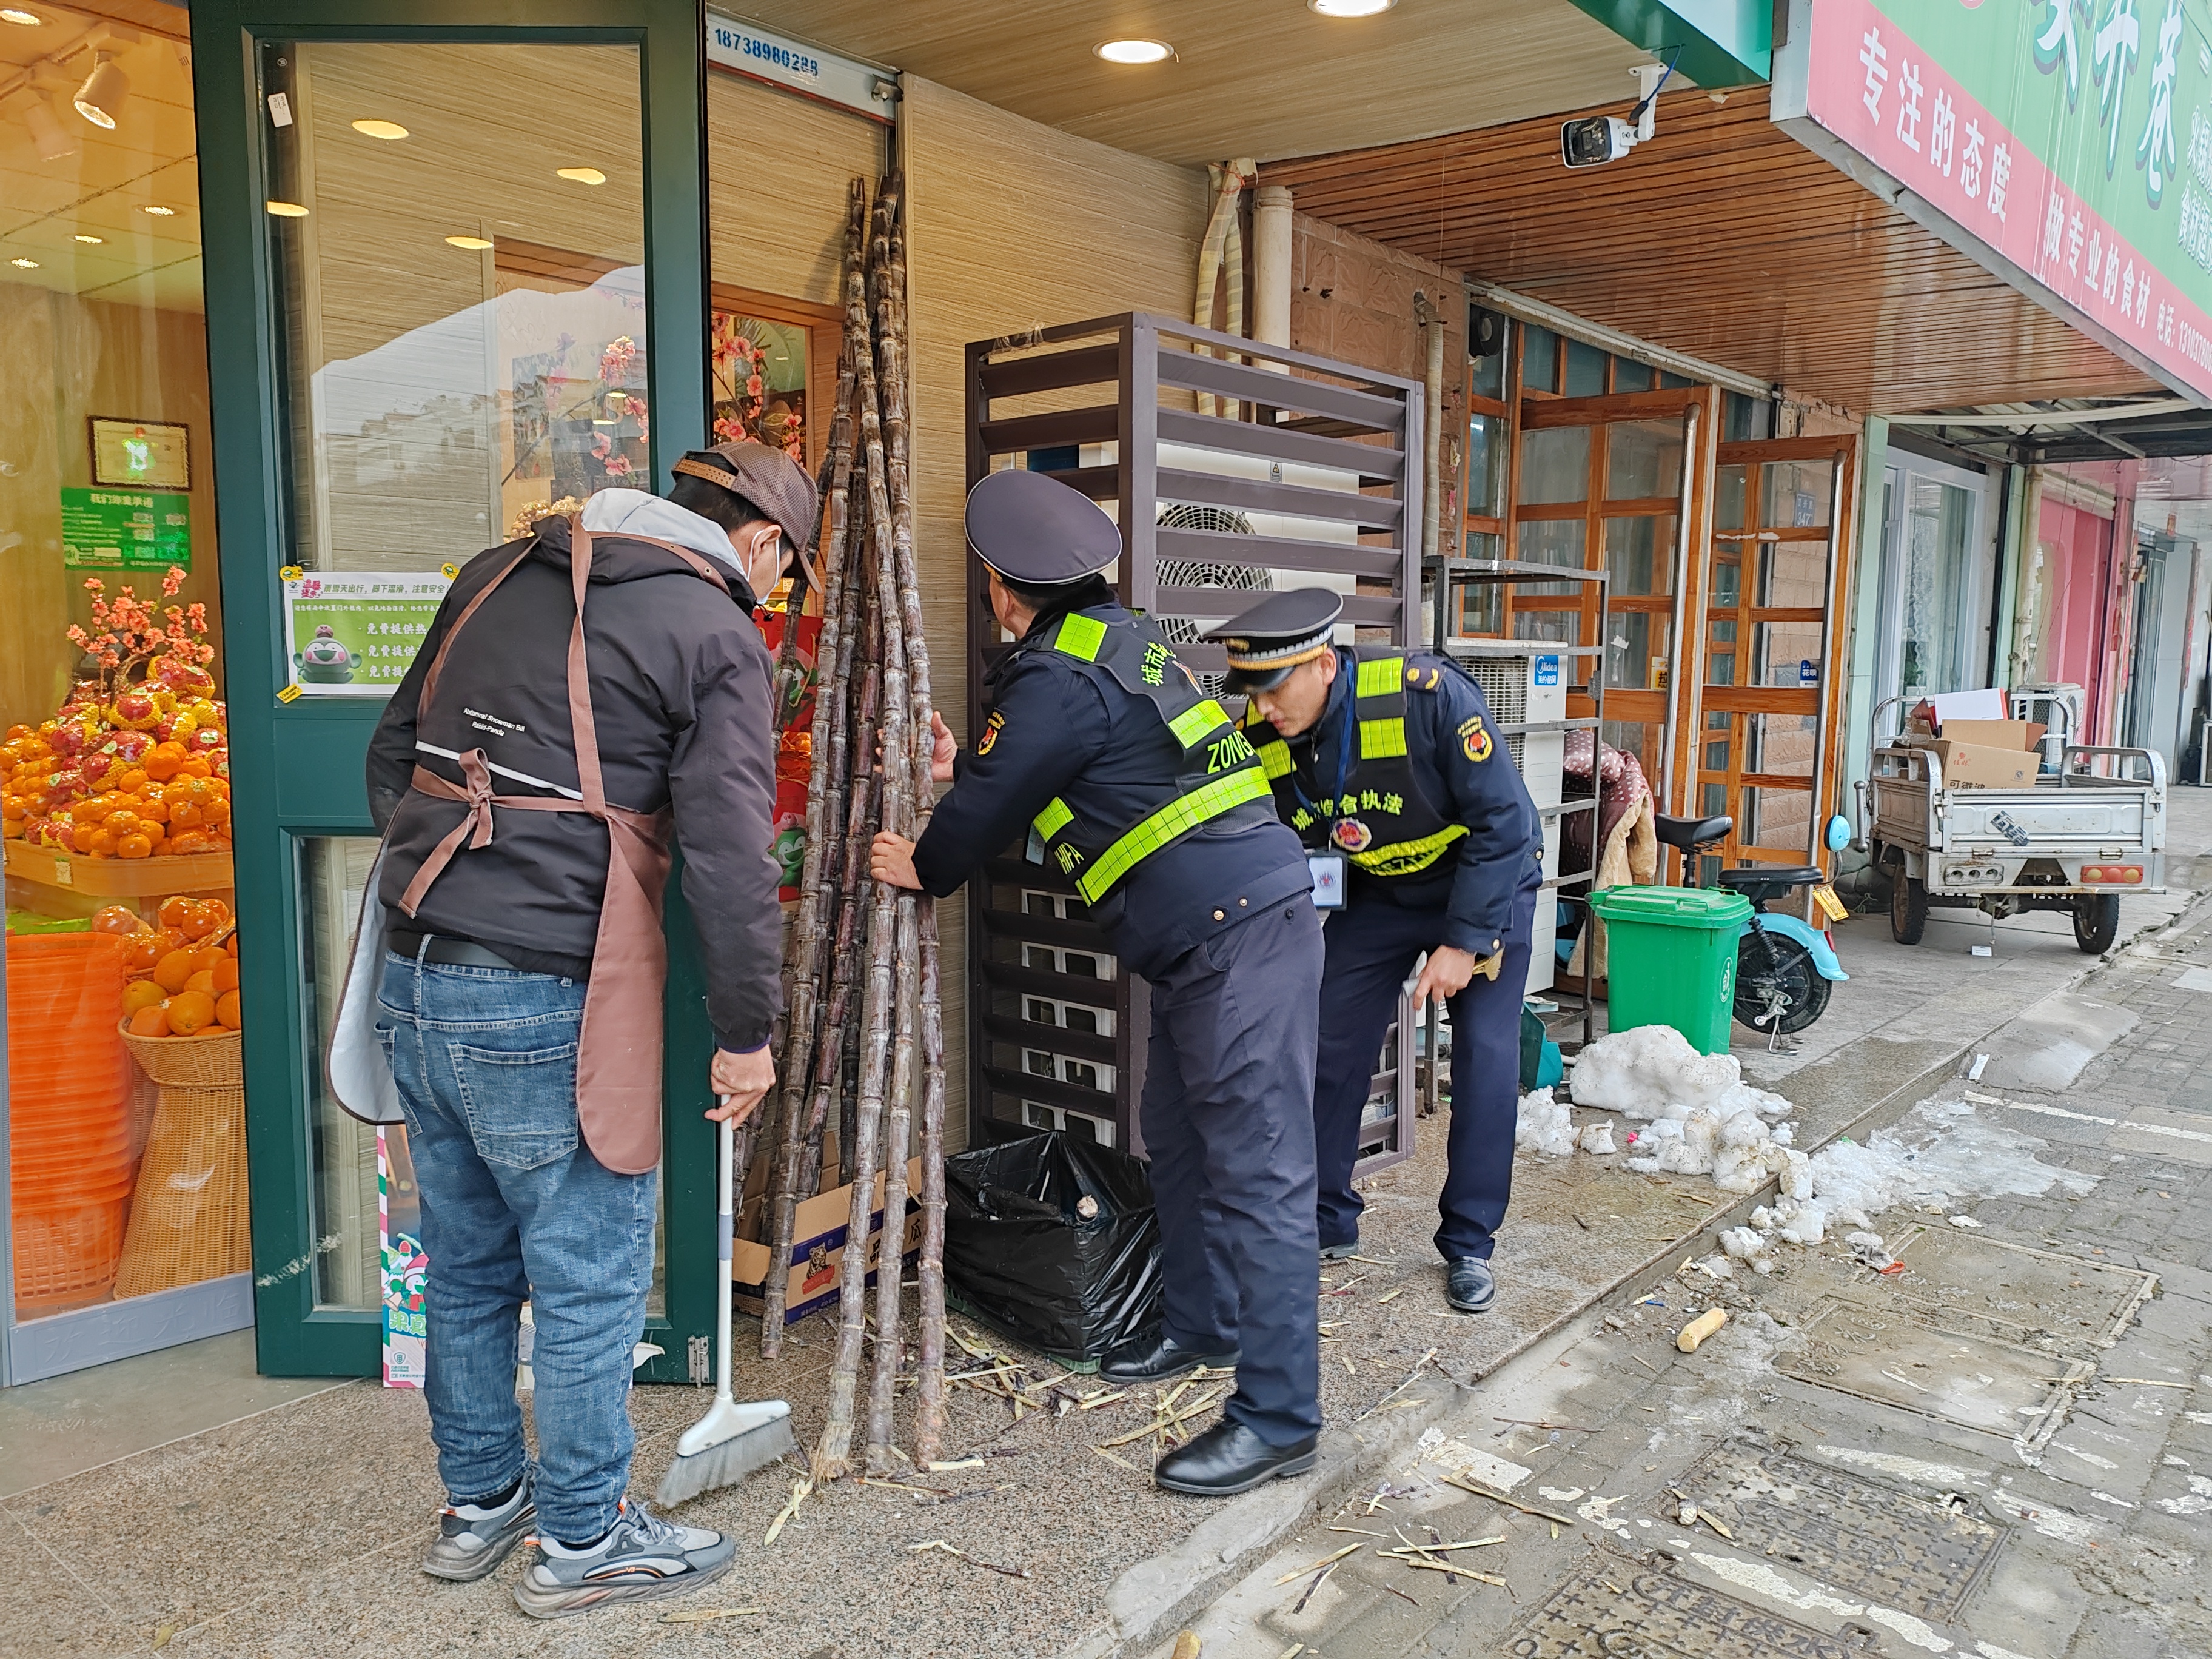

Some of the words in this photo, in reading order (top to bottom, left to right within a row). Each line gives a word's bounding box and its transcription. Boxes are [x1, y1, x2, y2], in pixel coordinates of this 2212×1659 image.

[1860, 26, 2011, 223] 专注的态度
[2043, 189, 2151, 330] 做专业的食材
[1537, 655, 1557, 674] Midea
[487, 715, 515, 729] Snowman
[1054, 842, 1085, 875] HIFA
